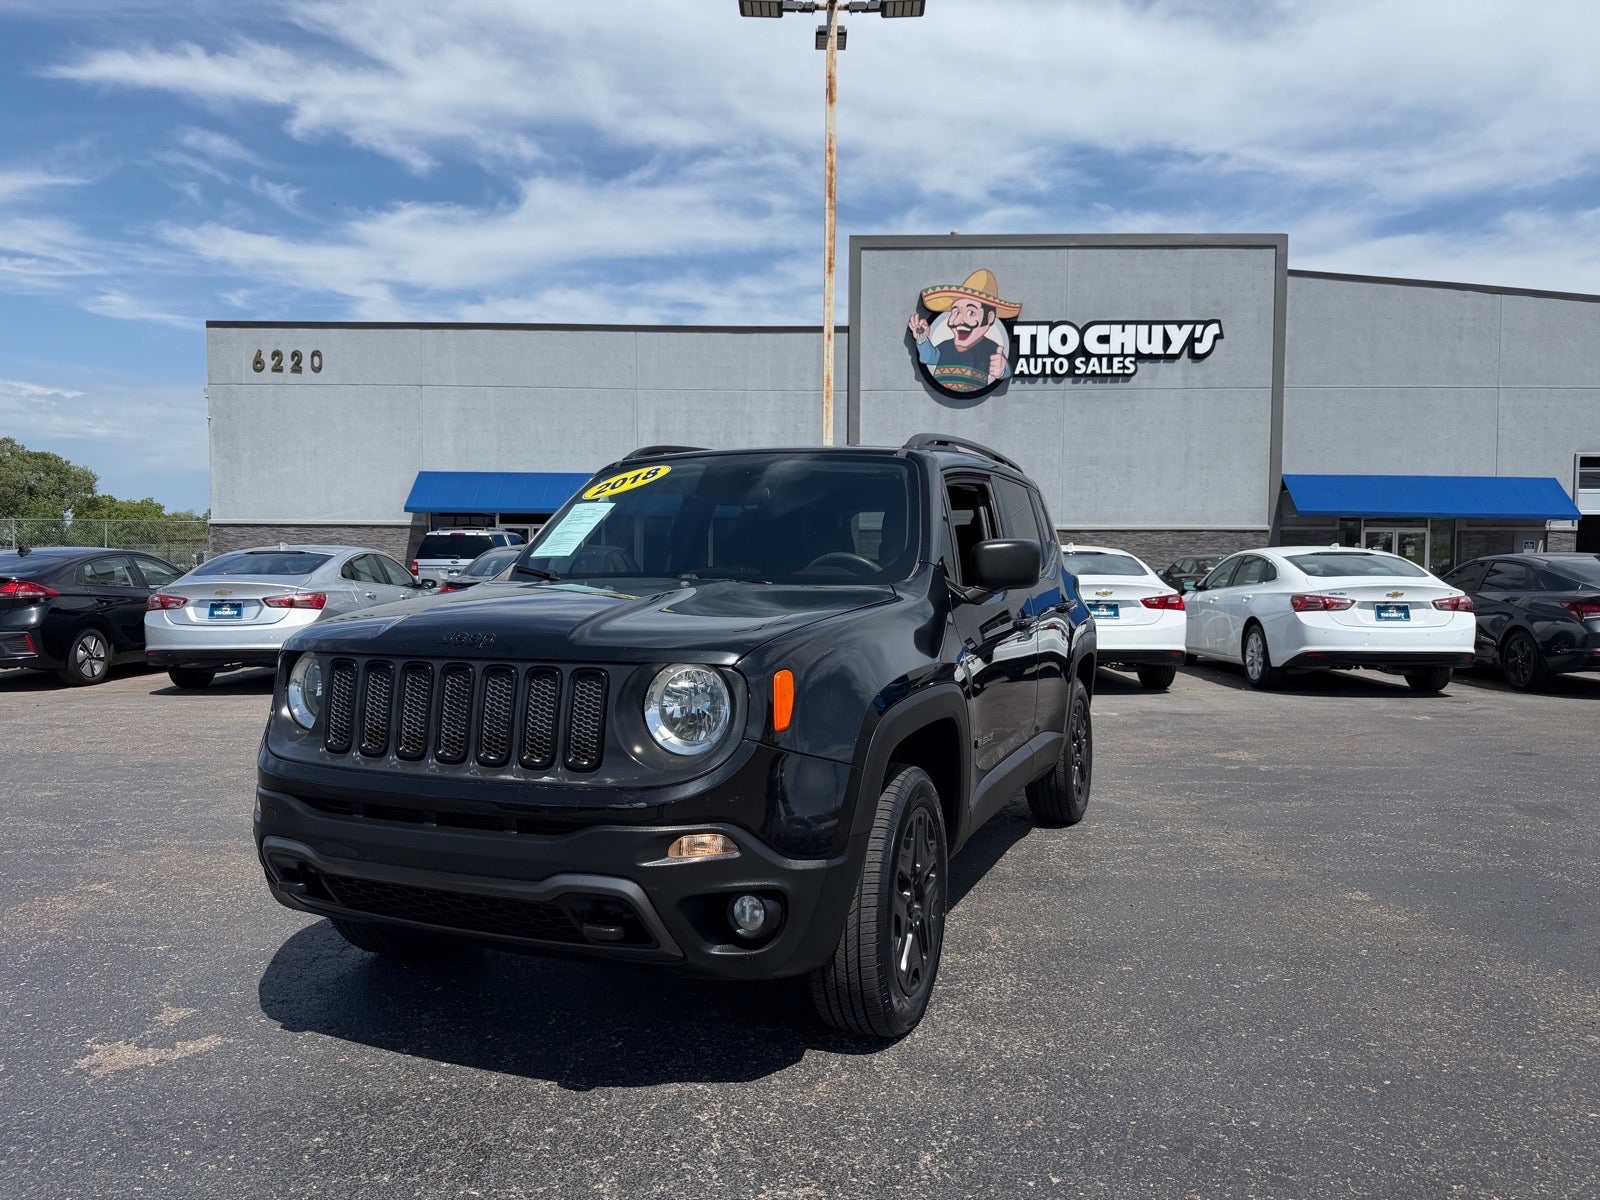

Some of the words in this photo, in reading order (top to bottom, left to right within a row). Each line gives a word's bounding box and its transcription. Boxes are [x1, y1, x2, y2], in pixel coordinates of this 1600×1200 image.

[1013, 325, 1080, 355] TIO
[1083, 323, 1221, 355] CHUY'S
[252, 349, 323, 374] 6220
[1014, 358, 1068, 374] AUTO
[1074, 357, 1136, 374] SALES
[591, 468, 661, 497] 2018
